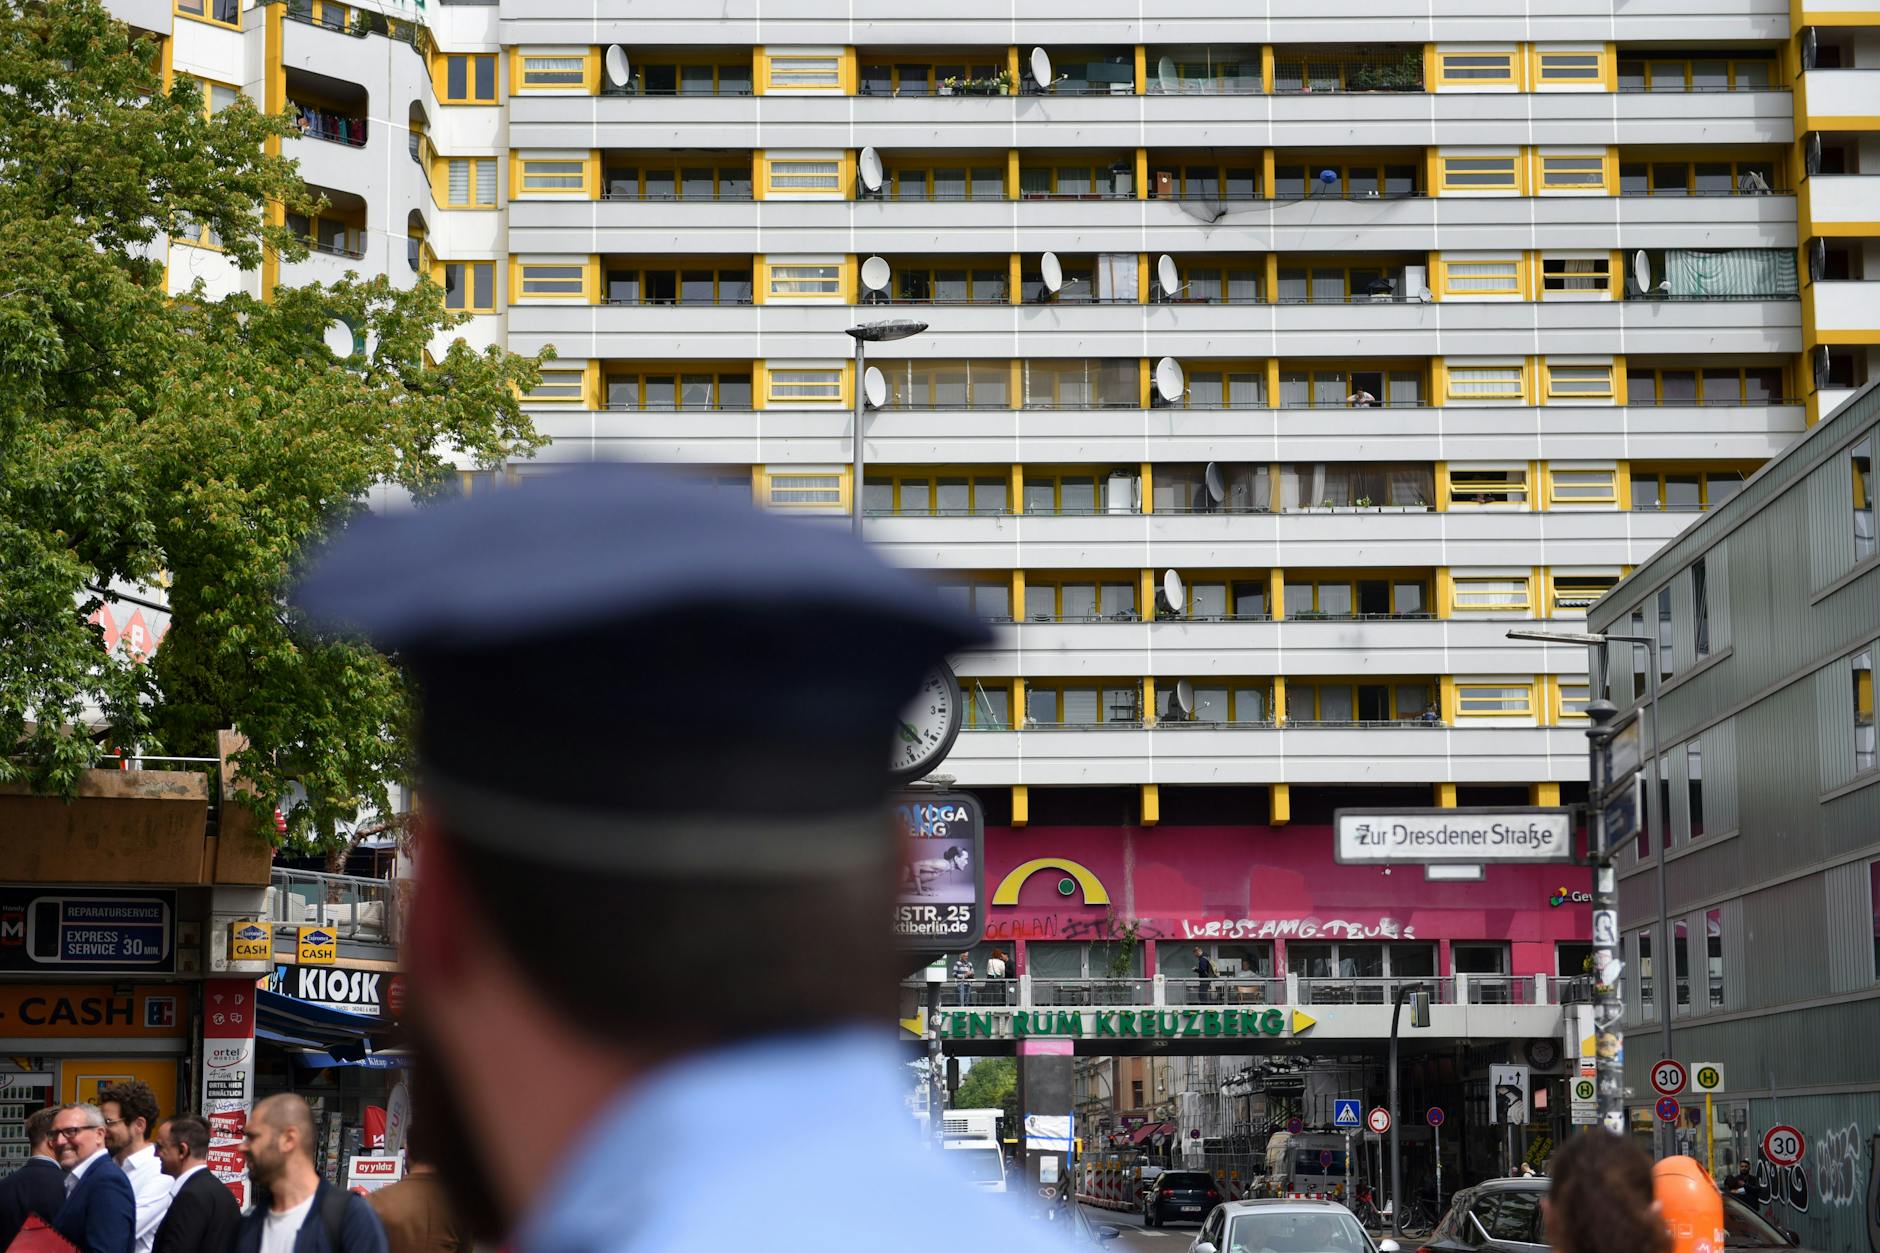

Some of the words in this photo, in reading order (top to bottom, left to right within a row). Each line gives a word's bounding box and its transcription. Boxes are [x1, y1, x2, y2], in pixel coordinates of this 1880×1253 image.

[1358, 824, 1387, 846] Zur
[1393, 824, 1489, 846] Dresdener
[1491, 823, 1553, 849] Straße
[2, 904, 25, 914] Handy
[67, 906, 160, 919] REPARATURSERVICE
[947, 905, 971, 922] 25
[1, 920, 24, 938] M
[66, 931, 119, 943] EXPRESS
[306, 934, 331, 942] Euronet
[68, 943, 117, 955] SERVICE
[122, 938, 143, 956] 30
[144, 946, 161, 956] MIN.
[235, 944, 267, 955] CASH
[302, 949, 332, 959] CASH
[299, 967, 381, 1004] KIOSK
[18, 997, 135, 1026] CASH
[1096, 1008, 1285, 1037] KREUZBERG
[213, 1048, 240, 1057] ortel
[1658, 1069, 1680, 1086] 30
[1703, 1073, 1714, 1083] H
[208, 1089, 243, 1097] ERHÄLTLICH
[1580, 1085, 1590, 1096] H
[1773, 1137, 1796, 1155] 30
[208, 1150, 235, 1158] INTERNET
[359, 1164, 370, 1173] ay
